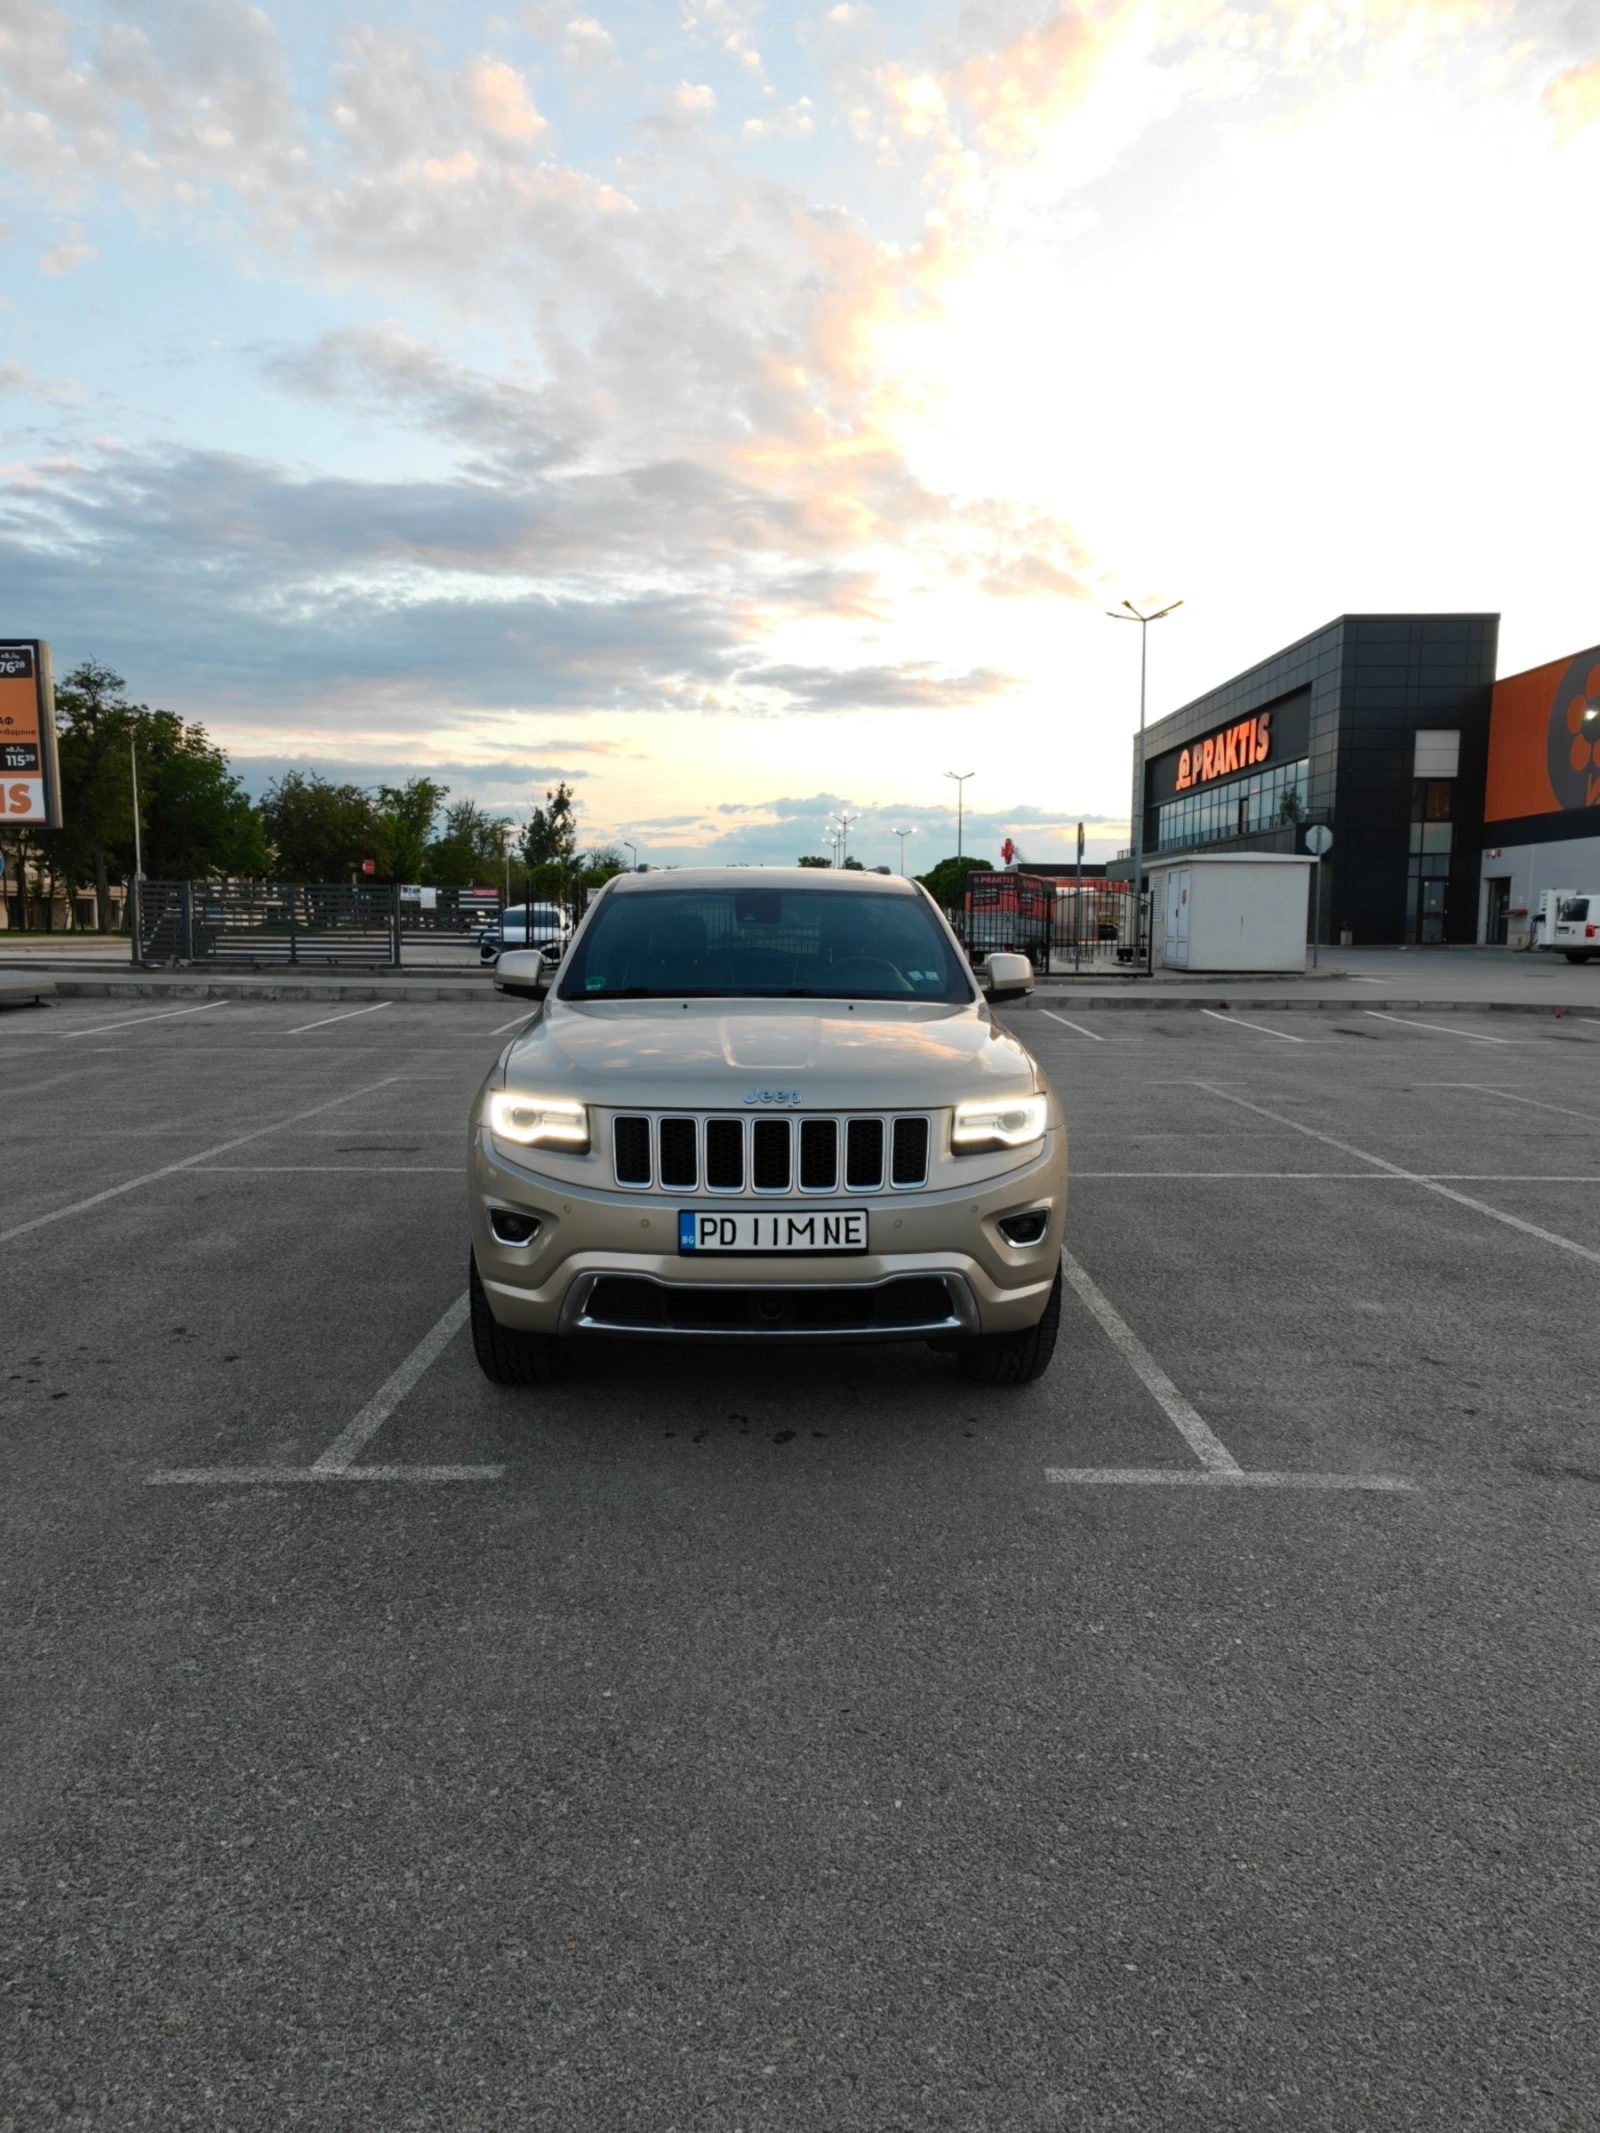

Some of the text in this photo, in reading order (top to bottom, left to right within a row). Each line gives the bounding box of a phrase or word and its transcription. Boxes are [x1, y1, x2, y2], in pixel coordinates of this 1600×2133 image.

[1192, 712, 1270, 785] PRAKTIS
[980, 876, 1015, 884] PRAKTIS
[742, 1087, 801, 1107] Jeep
[682, 1235, 695, 1244] BG
